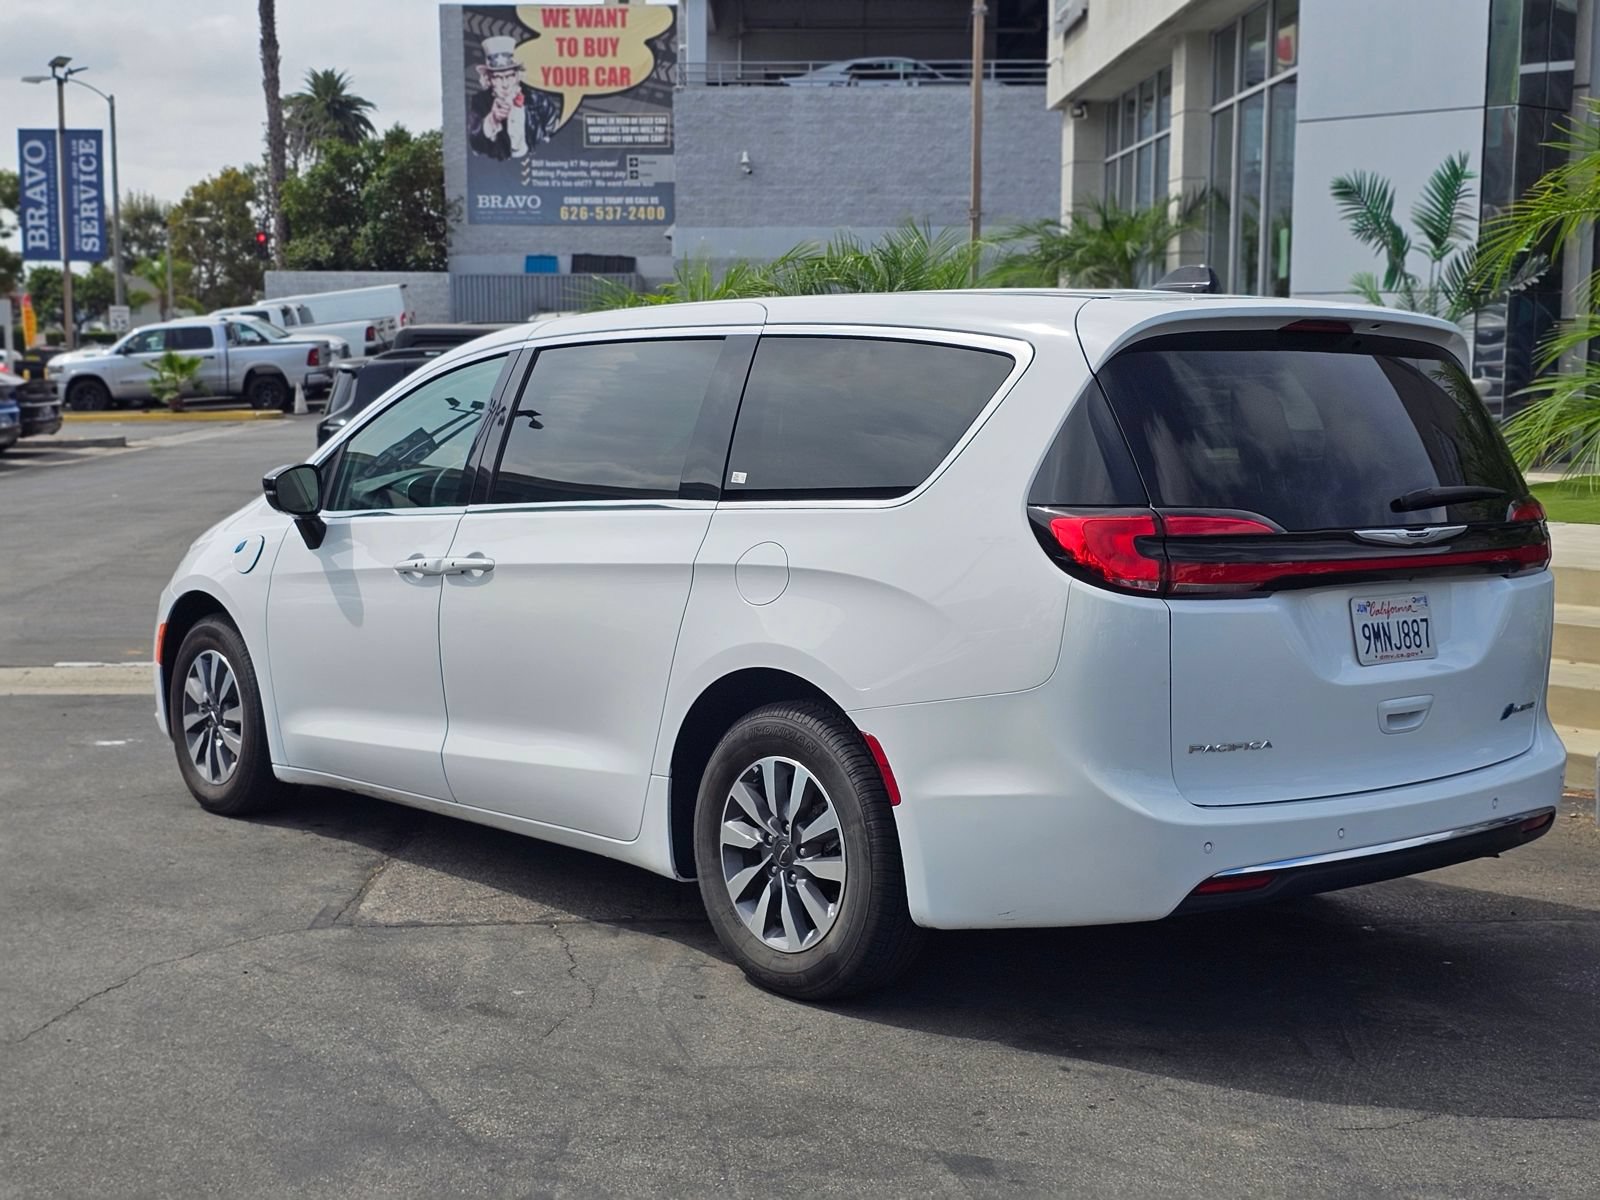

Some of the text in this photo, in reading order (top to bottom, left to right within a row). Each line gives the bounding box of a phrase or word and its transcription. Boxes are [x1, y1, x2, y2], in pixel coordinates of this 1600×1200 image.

[541, 8, 629, 28] WE WANT
[556, 37, 620, 58] TO BUY
[541, 66, 631, 87] YOUR CAR
[634, 135, 649, 143] YOUR
[23, 140, 50, 250] BRAVO
[79, 139, 100, 253] SERVICE
[476, 194, 542, 209] BRAVO
[559, 206, 665, 220] 626-537-2400
[1369, 600, 1418, 620] California
[1361, 617, 1430, 655] 9MNJ887
[1380, 652, 1419, 660] dmv.ca.gov
[748, 725, 818, 754] IRONMAN
[1188, 739, 1273, 754] PACIFICA
